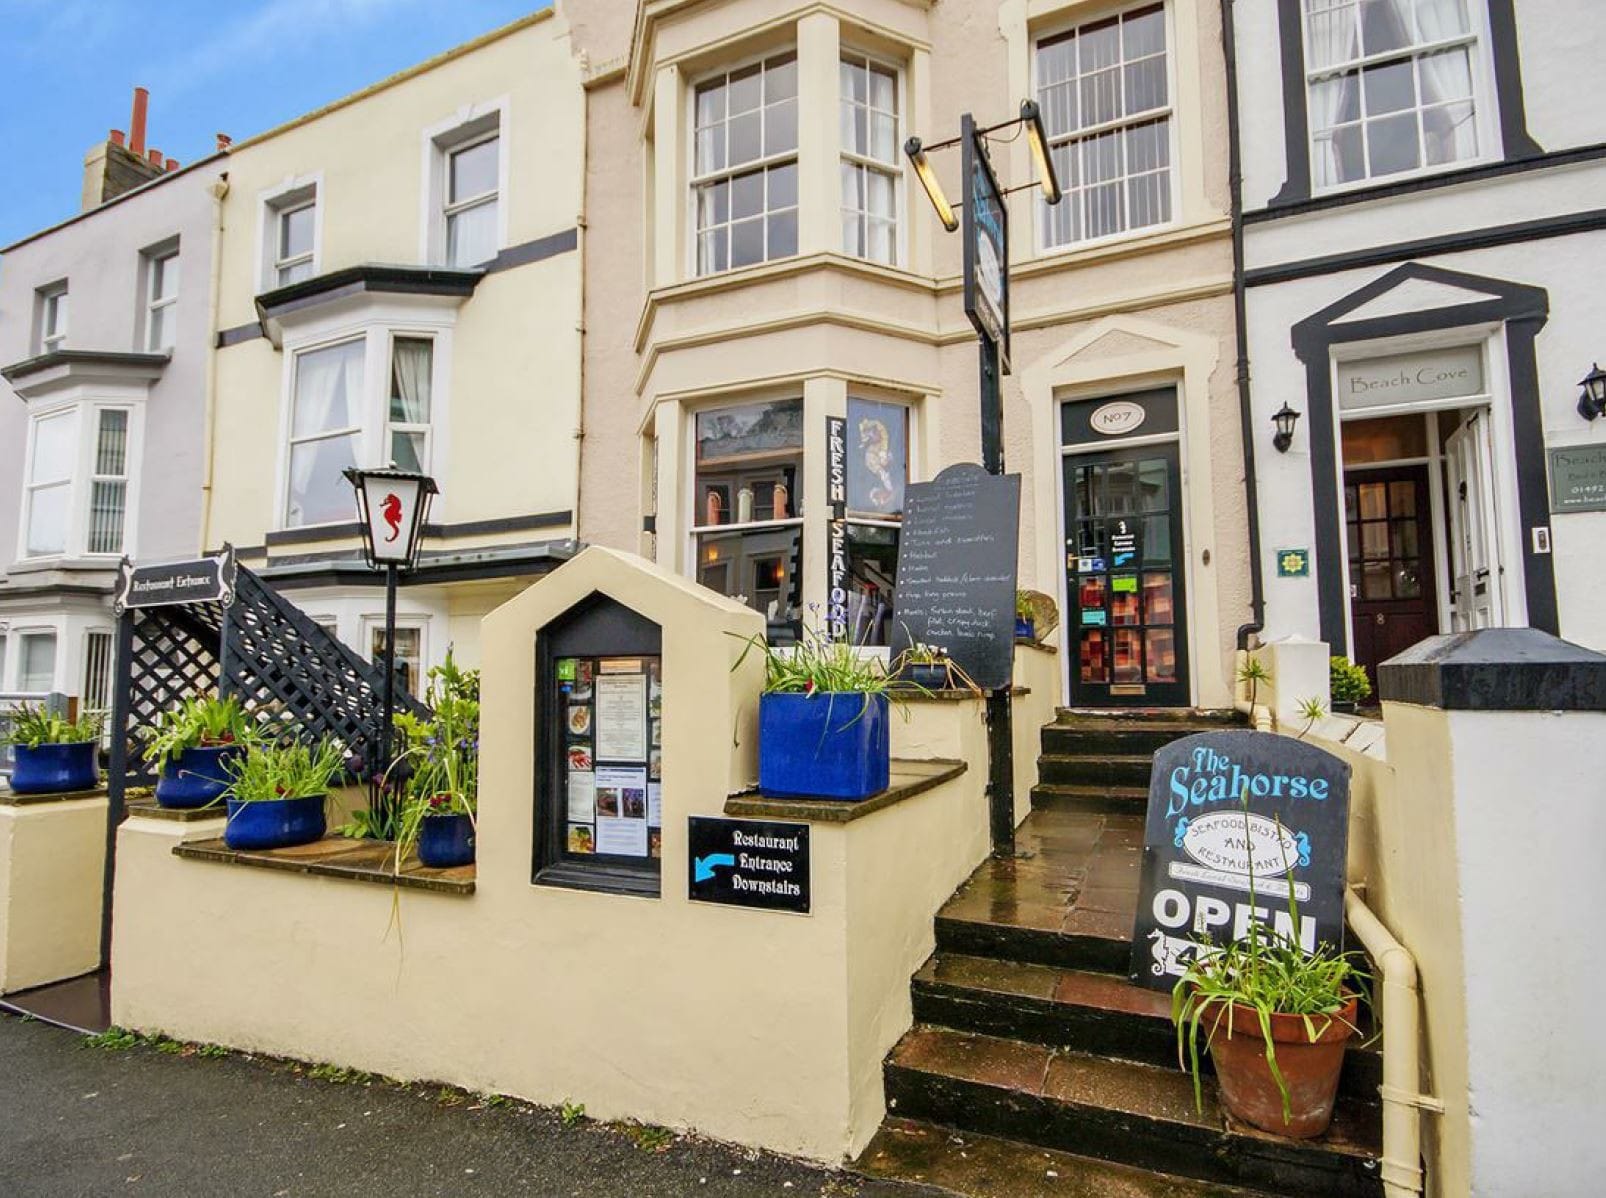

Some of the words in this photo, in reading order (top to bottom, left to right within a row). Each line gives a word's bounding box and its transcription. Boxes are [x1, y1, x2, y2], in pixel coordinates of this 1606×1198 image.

[1351, 369, 1410, 393] Beach
[1417, 368, 1468, 385] Cove
[831, 421, 845, 501] FRESH
[133, 576, 174, 592] Restaurant
[176, 574, 211, 588] Entrance
[831, 519, 846, 638] SEAFOOD
[1377, 613, 1384, 624] 8
[1192, 747, 1230, 775] The
[1165, 765, 1328, 819] Seahorse
[1192, 819, 1247, 837] SEAFOOD
[733, 830, 799, 853] Restaurant
[1224, 837, 1256, 851] AND
[739, 853, 793, 874] Entrance
[732, 874, 800, 896] Downstairs
[1153, 889, 1317, 957] OPEN
